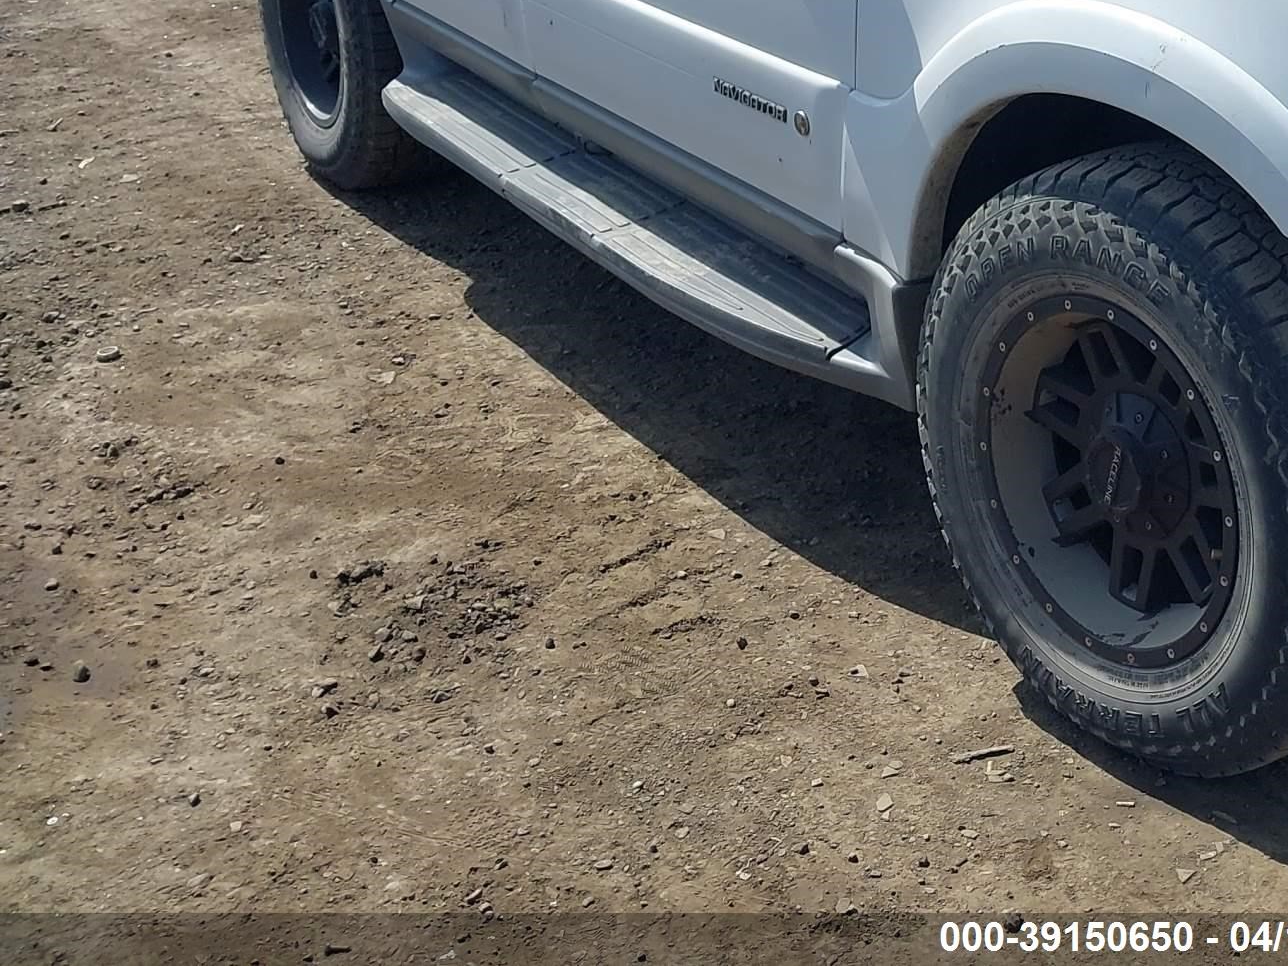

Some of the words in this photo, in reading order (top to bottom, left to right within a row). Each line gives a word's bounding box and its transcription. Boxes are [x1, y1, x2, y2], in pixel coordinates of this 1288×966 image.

[963, 235, 1035, 302] OPEN
[1050, 234, 1170, 305] RANGE
[1103, 444, 1122, 506] RACELINE
[1175, 681, 1231, 734] ALL
